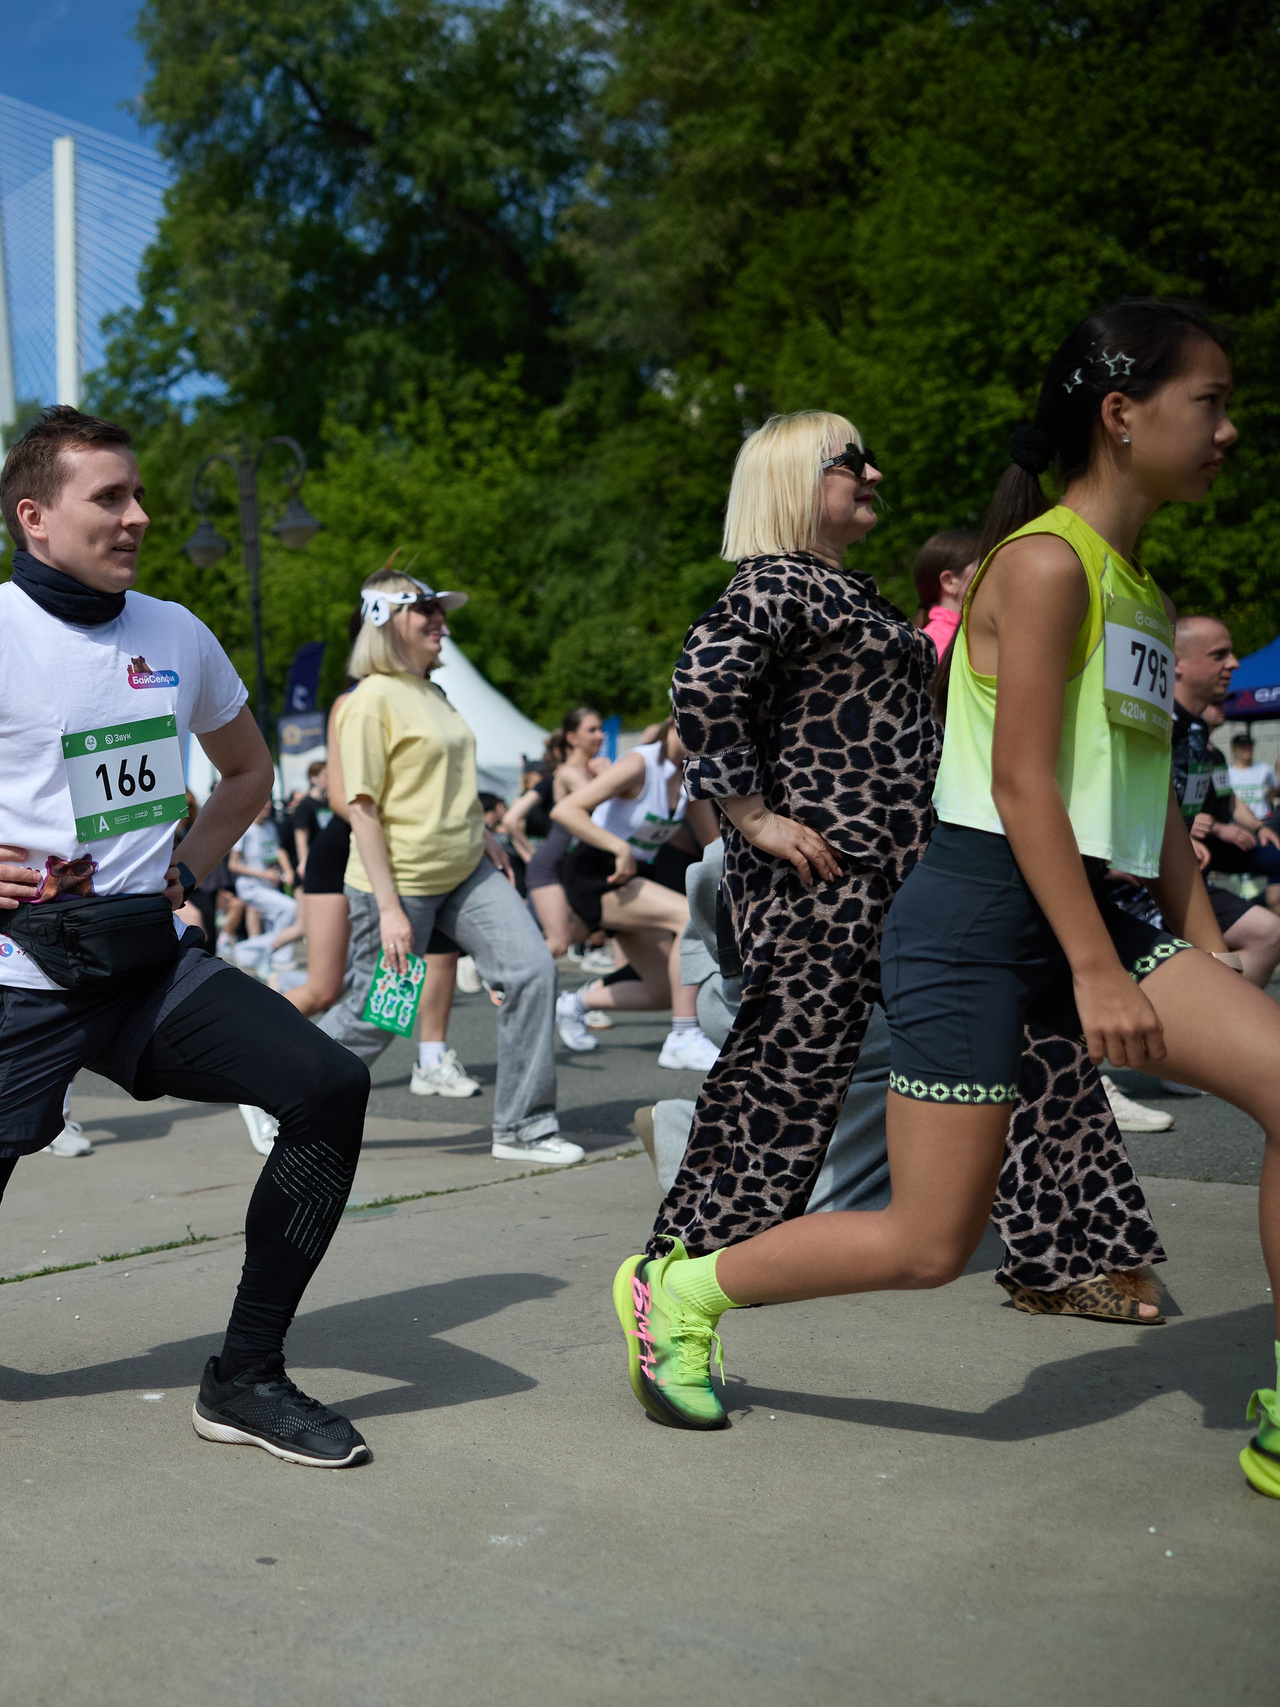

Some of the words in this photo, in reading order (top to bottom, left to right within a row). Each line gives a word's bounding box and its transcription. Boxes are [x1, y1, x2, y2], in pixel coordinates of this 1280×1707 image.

[132, 673, 175, 685] БайСелфи
[1131, 640, 1167, 700] 795
[114, 733, 132, 743] Звук
[95, 754, 156, 801] 166
